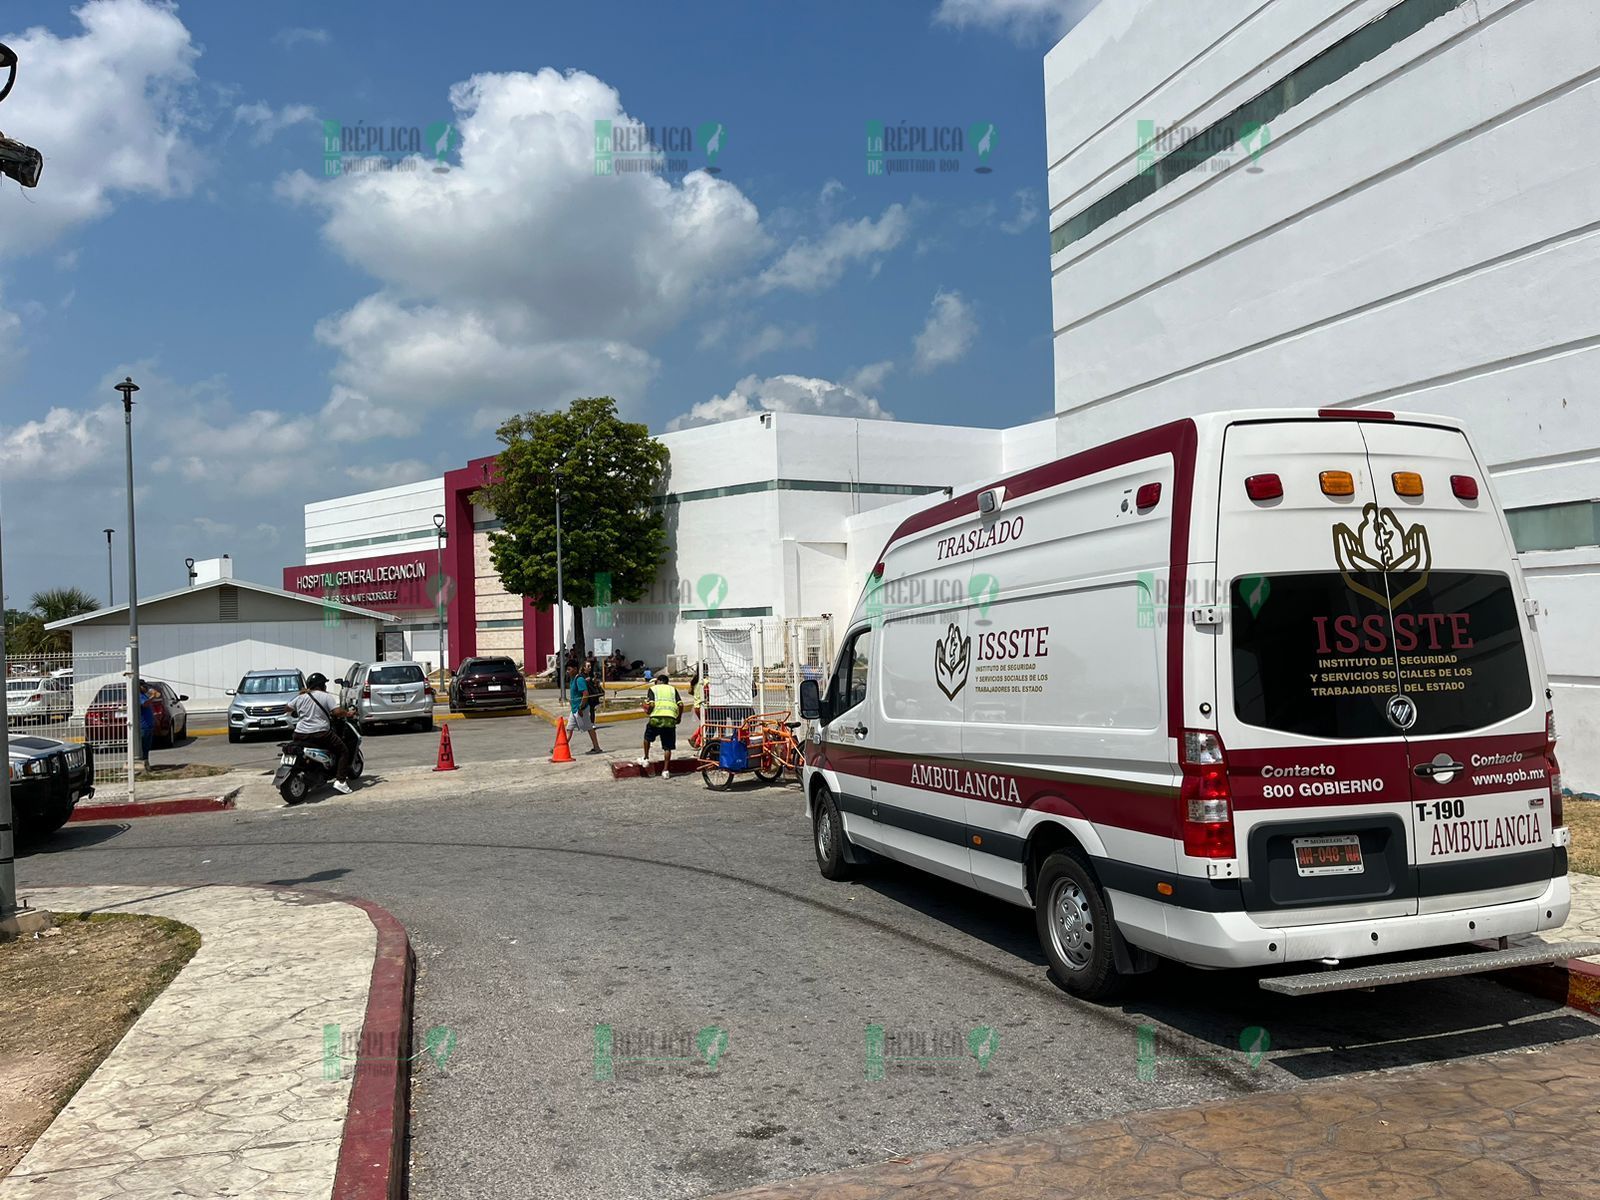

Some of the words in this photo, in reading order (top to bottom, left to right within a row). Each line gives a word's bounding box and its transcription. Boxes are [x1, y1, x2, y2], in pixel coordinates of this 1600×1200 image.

[937, 516, 1024, 560] TRASLADO
[297, 573, 334, 589] HOSPITAL
[336, 568, 376, 586] GENERAL
[977, 626, 1049, 660] ISSSTE
[1313, 613, 1473, 654] ISSSTE
[976, 664, 999, 672] INSTITUTO
[1000, 664, 1006, 672] DE
[1007, 663, 1036, 672] SEGURIDAD
[1319, 658, 1377, 668] INSTITUTO
[1381, 657, 1394, 666] DE
[1400, 655, 1458, 665] SEGURIDAD
[1004, 674, 1028, 682] SOCIALES
[1310, 674, 1318, 682] Y
[1322, 671, 1380, 682] SERVICIOS
[1439, 668, 1451, 677] DE
[1454, 668, 1472, 676] LOS
[1311, 684, 1398, 696] TRABAJADORES
[1404, 683, 1424, 692] DEL
[1427, 681, 1465, 691] ESTADO
[1471, 752, 1523, 767] Contacto
[1261, 763, 1336, 778] Contacto
[1472, 768, 1545, 786] www.gob.mx
[910, 763, 1022, 804] AMBULANCIA
[1263, 784, 1294, 798] 800
[1299, 778, 1384, 796] GOBIERNO
[1416, 799, 1465, 822] T-190
[1431, 812, 1542, 856] AMBULANCIA
